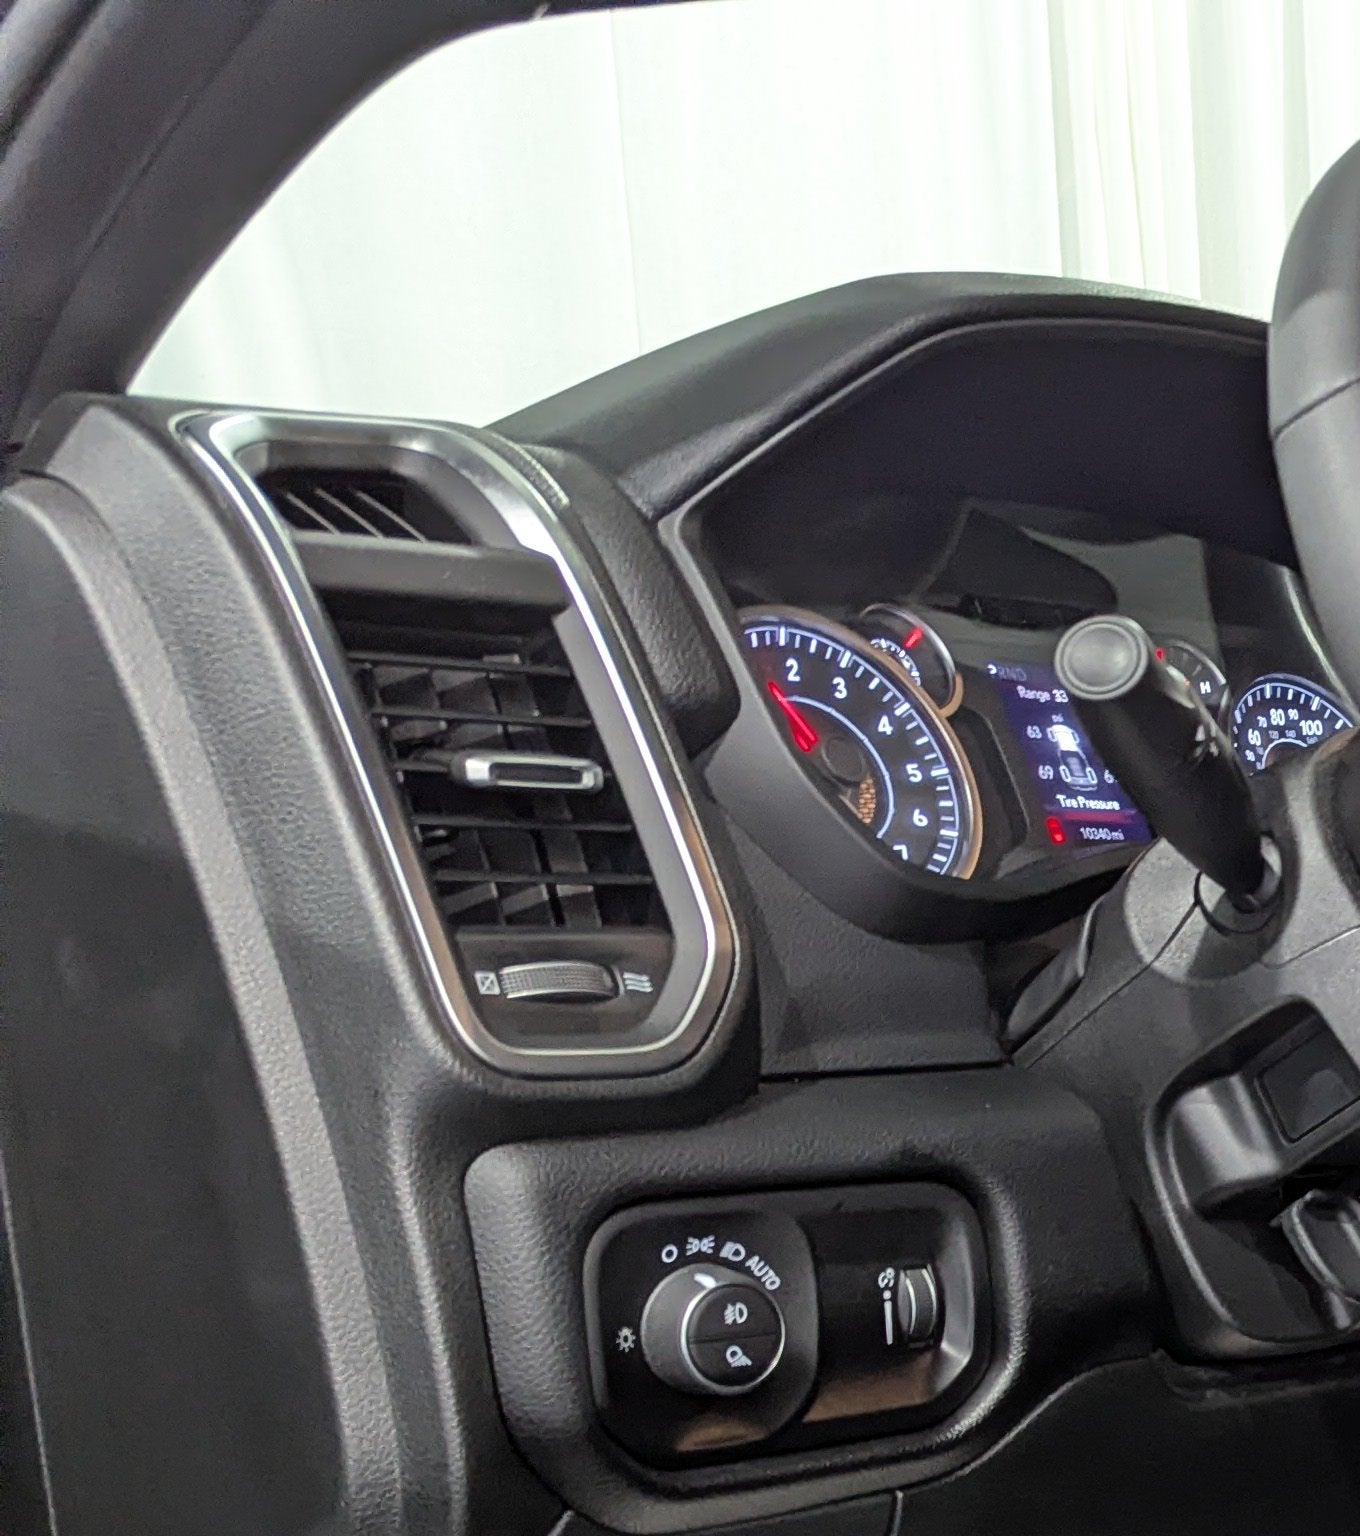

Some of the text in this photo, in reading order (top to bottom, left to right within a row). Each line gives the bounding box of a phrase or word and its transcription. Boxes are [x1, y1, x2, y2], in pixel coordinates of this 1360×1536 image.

[785, 657, 801, 682] 2
[831, 677, 848, 699] 3
[1016, 685, 1051, 703] Range
[877, 714, 894, 735] 4
[905, 763, 923, 783] 5
[1055, 794, 1121, 811] Tire Pressure
[912, 808, 929, 827] 6
[744, 1254, 781, 1291] AUTO
